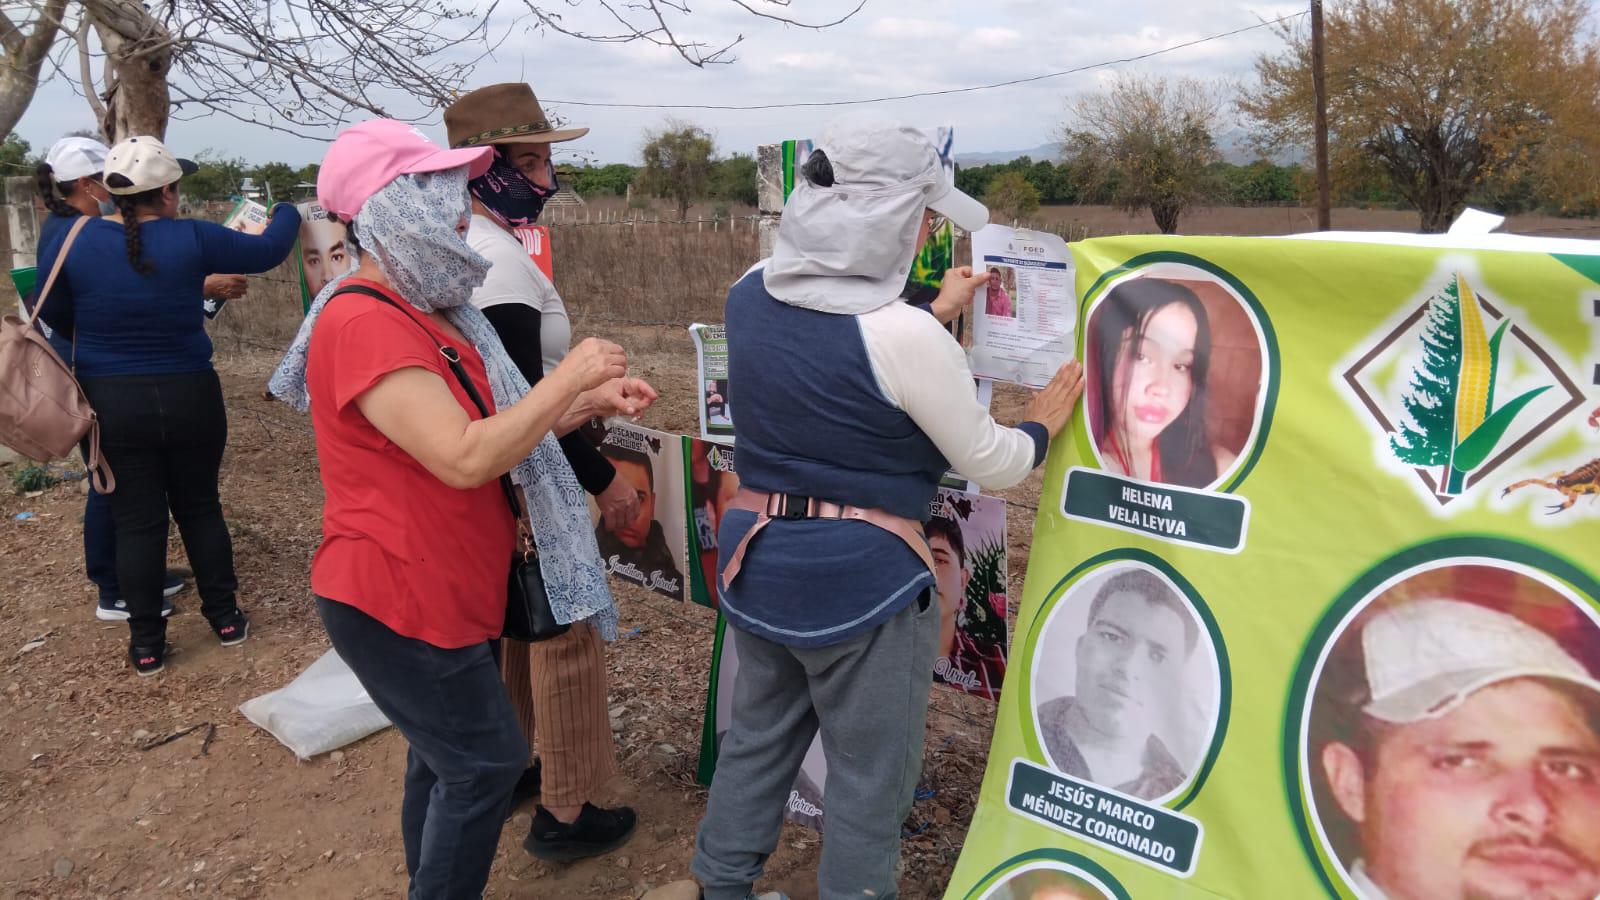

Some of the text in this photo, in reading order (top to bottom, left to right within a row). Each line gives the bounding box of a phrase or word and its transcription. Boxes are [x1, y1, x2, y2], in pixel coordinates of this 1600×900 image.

[1122, 486, 1173, 511] HELENA
[1108, 504, 1187, 537] VELA LEYVA
[1048, 781, 1155, 831] JESÚS MARCO
[1022, 793, 1176, 863] MÉNDEZ CORONADO
